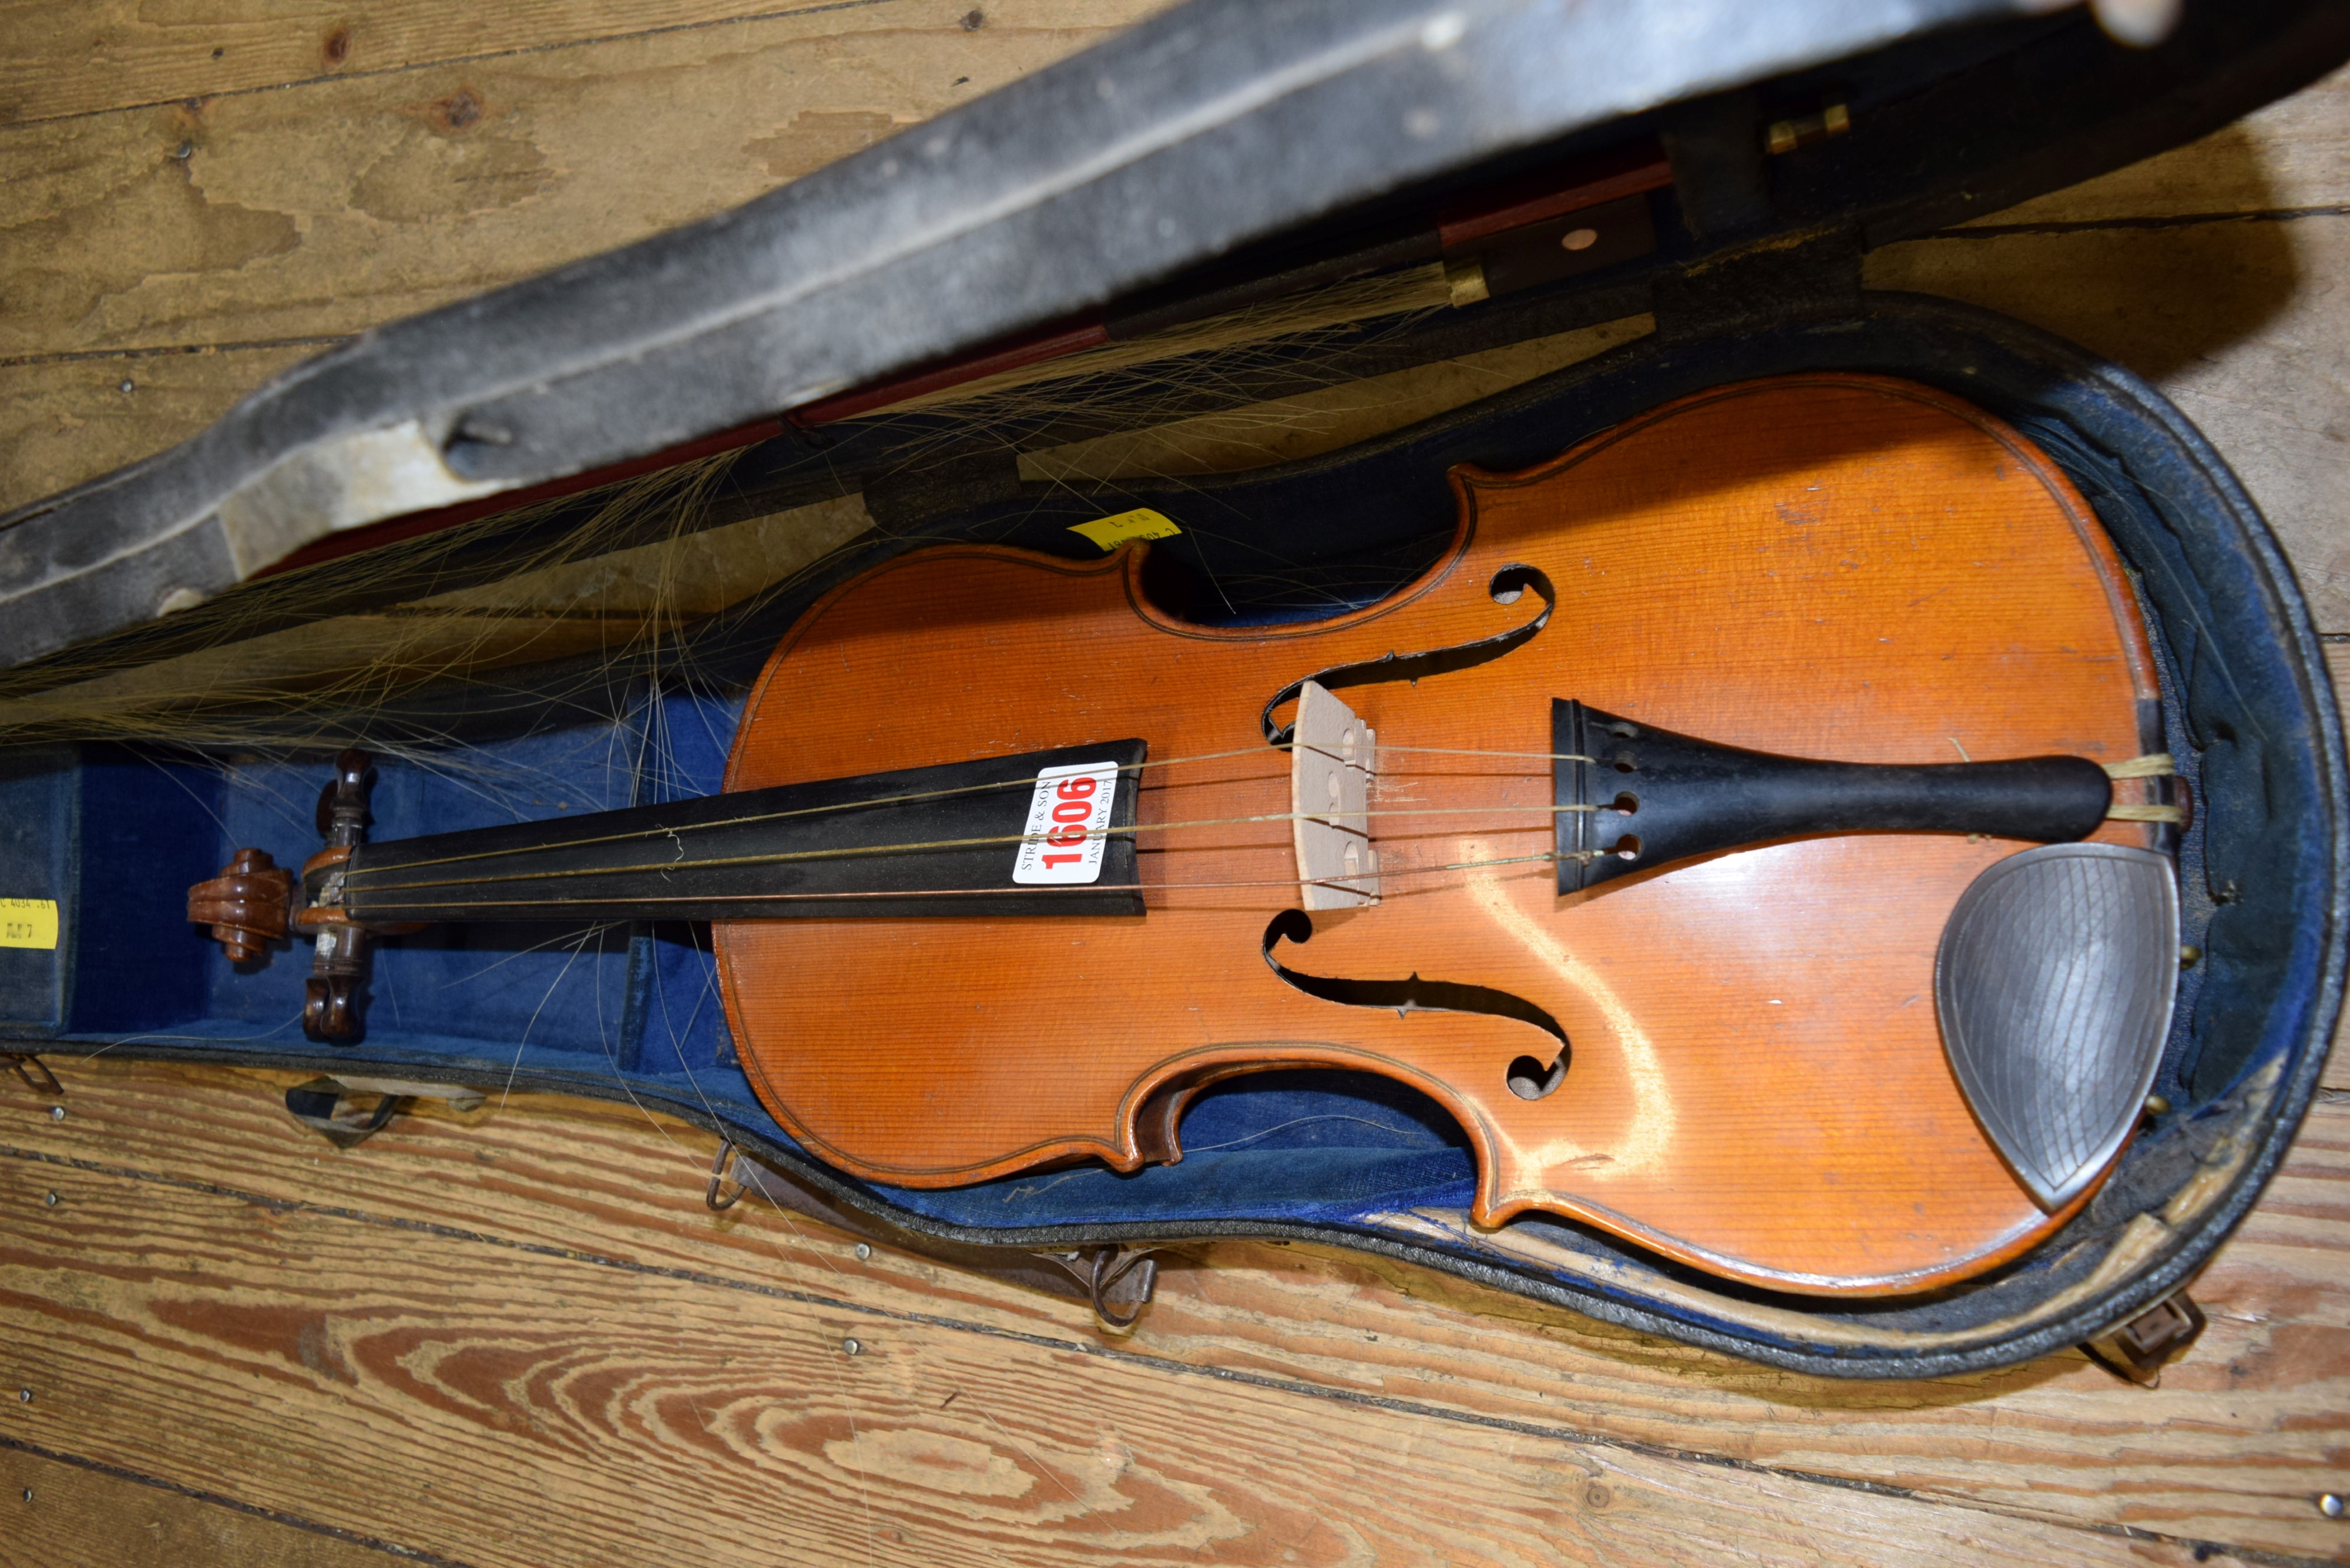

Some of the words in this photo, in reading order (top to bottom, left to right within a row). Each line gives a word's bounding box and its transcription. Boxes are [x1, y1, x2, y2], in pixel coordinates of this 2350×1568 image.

[1033, 811, 1045, 821] &
[1037, 781, 1051, 807] SON
[1041, 777, 1097, 869] 1606
[1088, 807, 1107, 865] JANUARY
[1100, 780, 1112, 804] 2017
[1021, 824, 1042, 871] STRIDE
